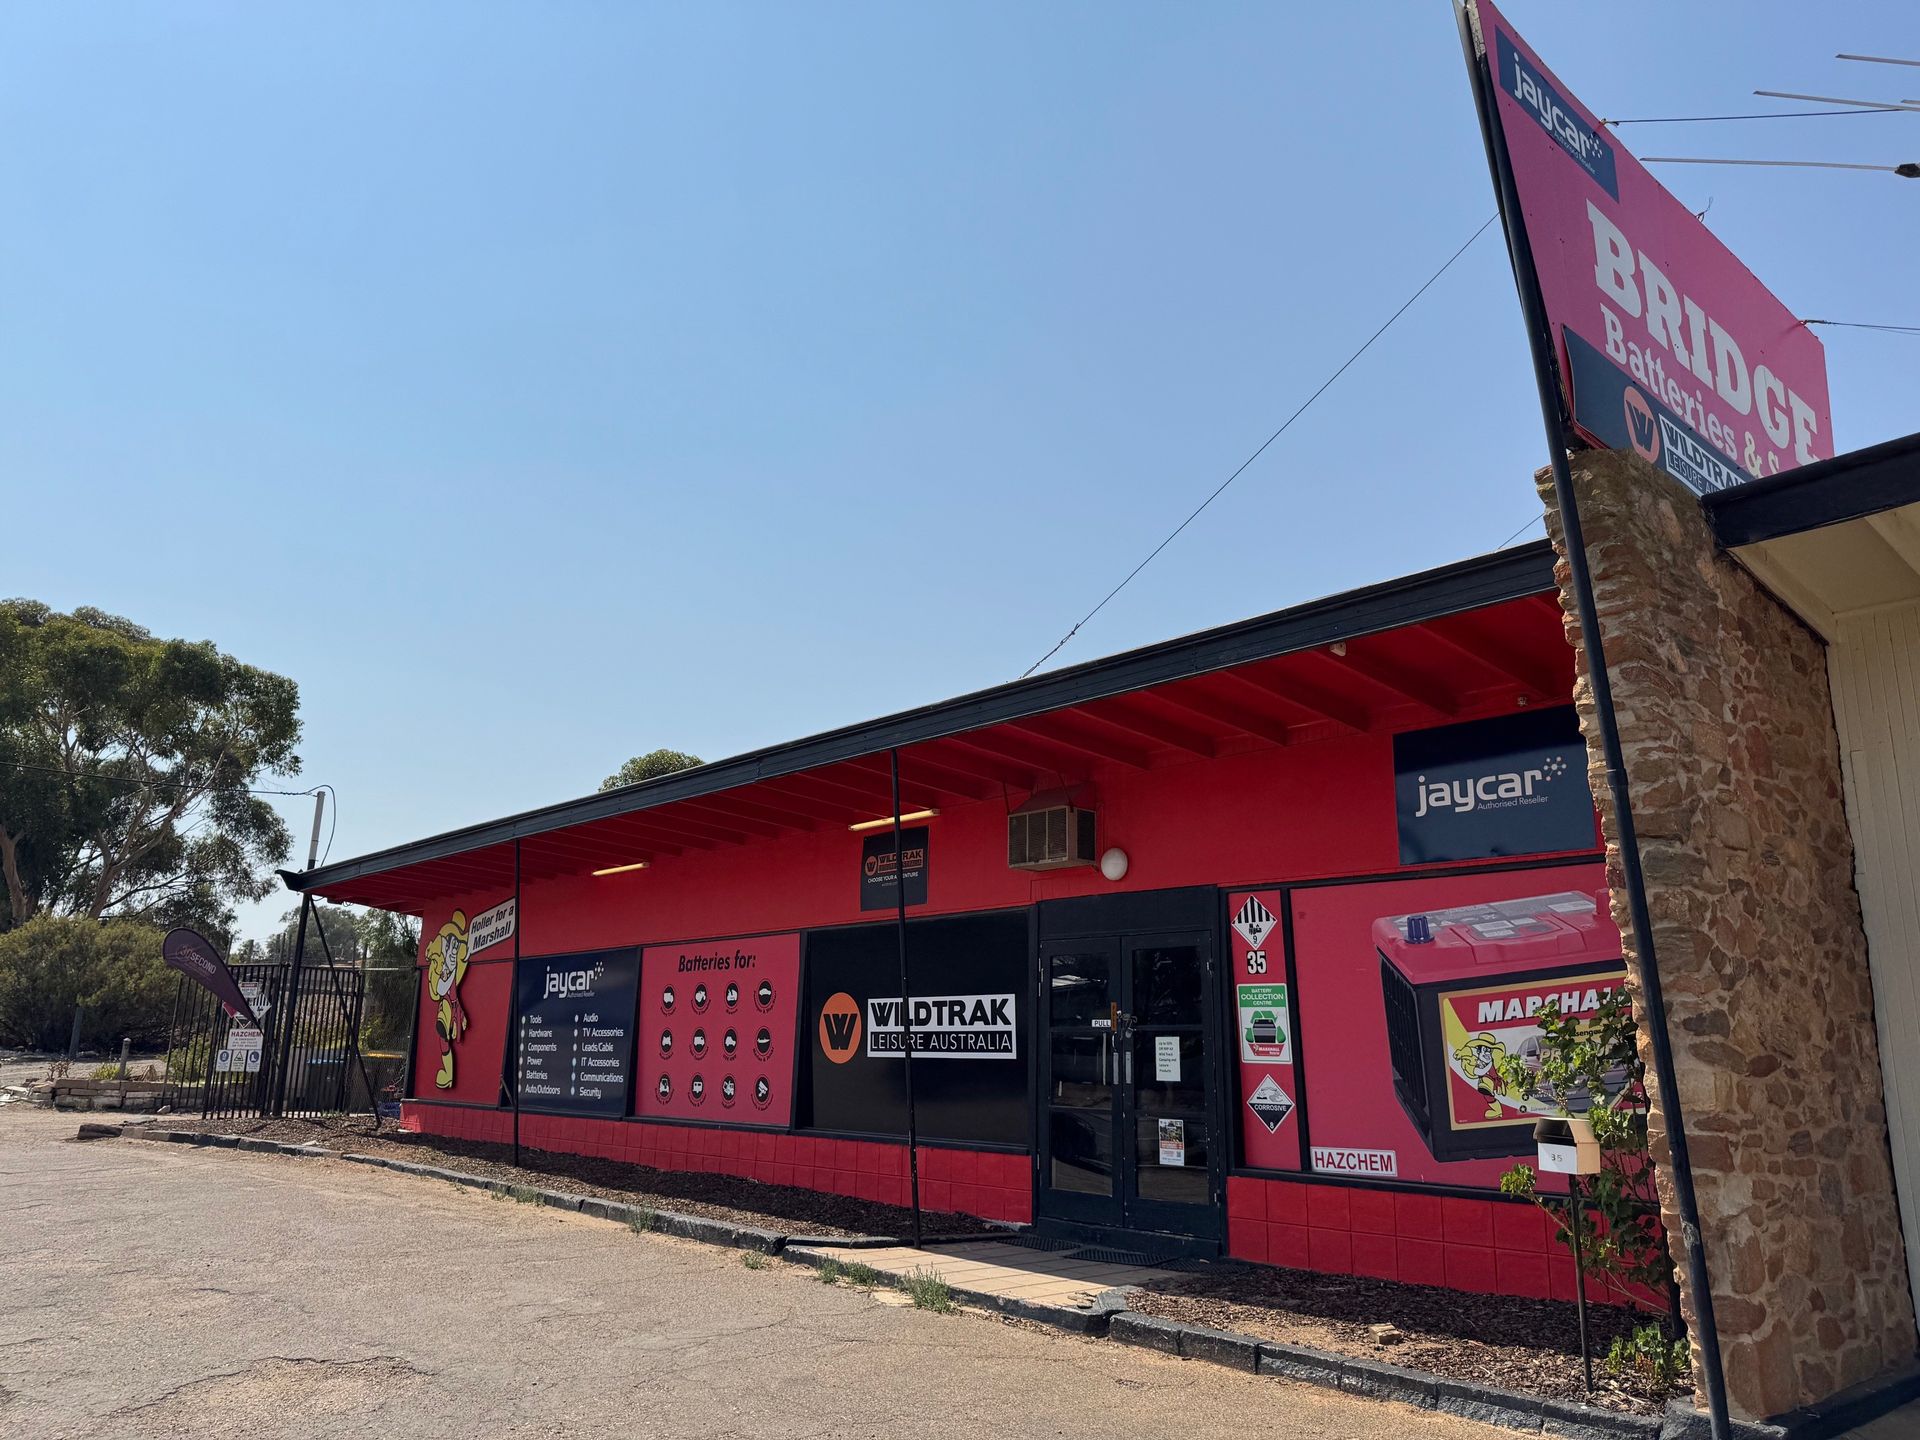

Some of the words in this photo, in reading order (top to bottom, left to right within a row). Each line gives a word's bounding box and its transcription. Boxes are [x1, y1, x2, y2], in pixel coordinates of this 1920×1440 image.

[1513, 52, 1591, 159] jaycar
[1586, 198, 1820, 466] BRIDGE
[1600, 303, 1738, 462] Batteries
[1668, 452, 1702, 491] LEISURE
[1415, 769, 1542, 817] jaycar
[1477, 797, 1518, 811] Authorised
[1518, 795, 1549, 806] Reseller
[880, 850, 922, 864] WILDRAK
[471, 915, 494, 934] Holler
[495, 908, 507, 922] for
[508, 905, 514, 916] a
[473, 920, 511, 950] Marshall
[678, 953, 730, 973] Batteries
[734, 949, 756, 969] for:
[1247, 951, 1267, 974] 35
[543, 965, 594, 999] jaycar
[1241, 993, 1284, 1001] COLLECTION
[530, 1015, 542, 1024] Tools
[583, 1013, 598, 1023] Audio
[871, 999, 1011, 1026] WILDTRAK
[528, 1029, 552, 1038] Hardware
[583, 1027, 591, 1037] TV
[591, 1027, 624, 1037] Accessories
[527, 1042, 557, 1053] Components
[872, 1034, 924, 1049] LEISURE
[929, 1033, 1011, 1050] AUSTRALIA
[527, 1056, 543, 1065] Power
[587, 1057, 620, 1068] Accessories
[526, 1070, 548, 1080] Batteries
[580, 1072, 624, 1083] Communications
[579, 1086, 602, 1099] Security
[1253, 1103, 1287, 1113] CORROSIVE
[1314, 1151, 1393, 1173] HAZCHEM
